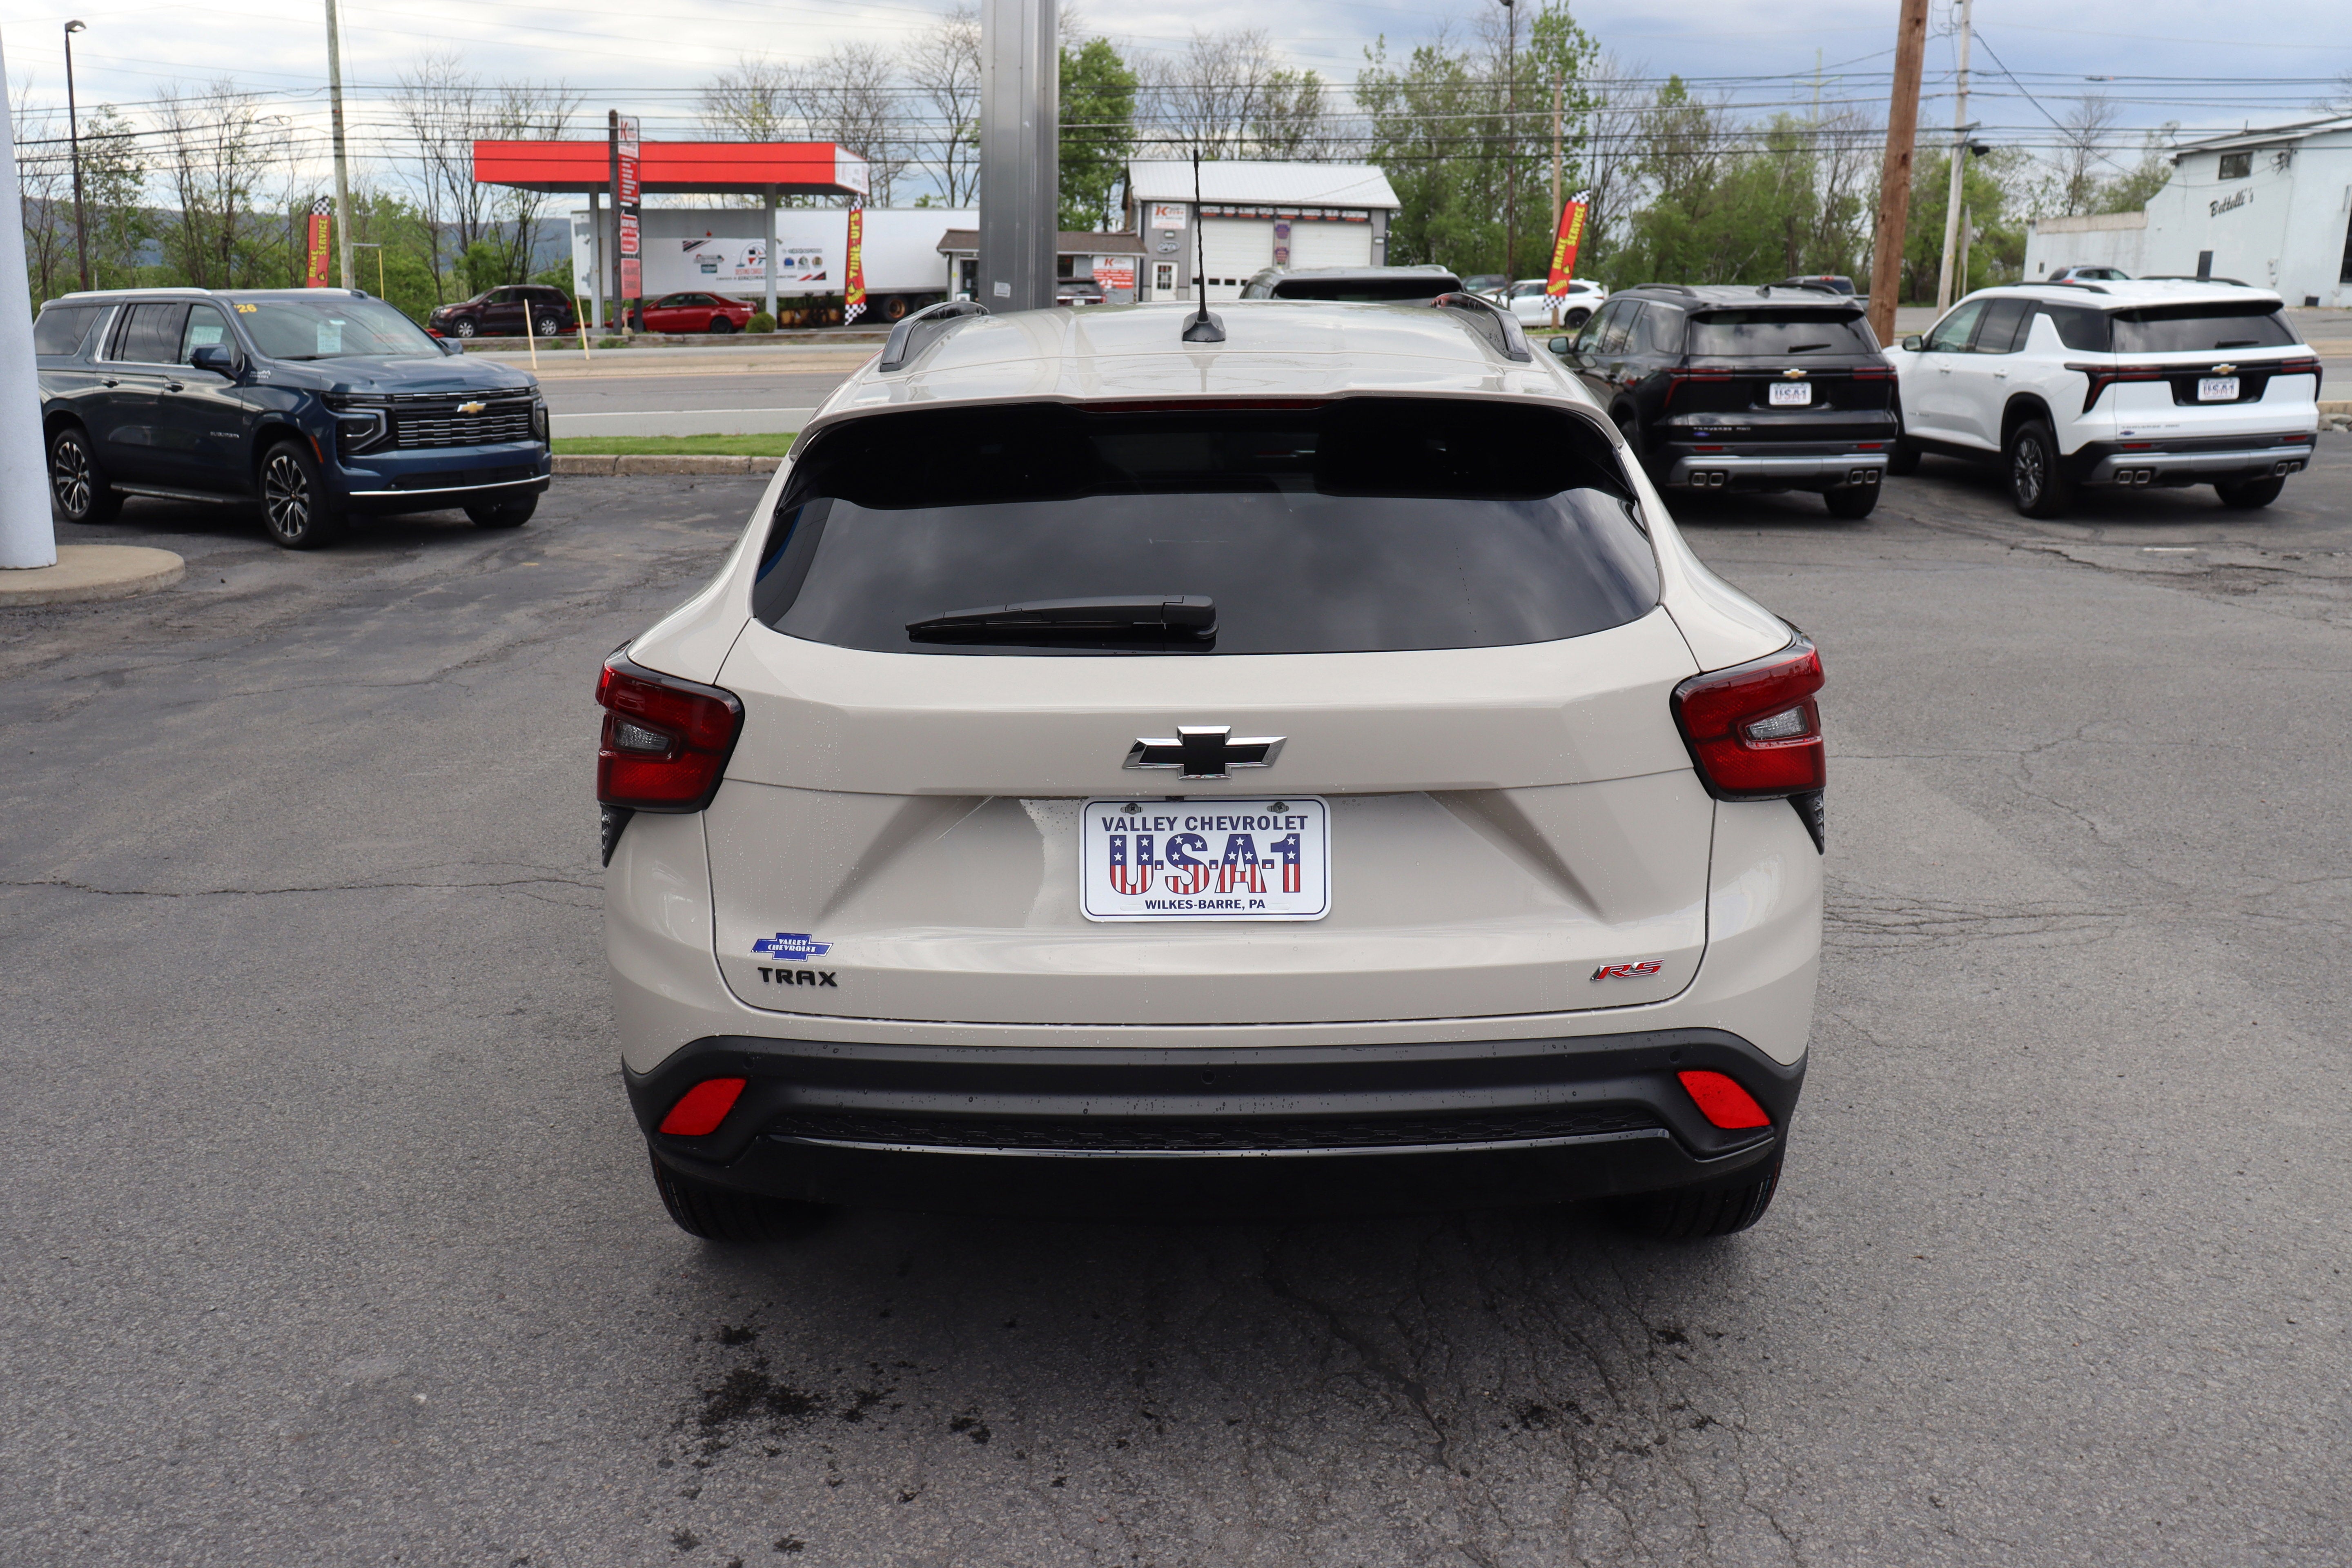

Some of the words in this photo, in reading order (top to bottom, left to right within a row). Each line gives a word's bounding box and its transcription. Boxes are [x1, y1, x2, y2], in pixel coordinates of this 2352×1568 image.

[318, 218, 327, 256] SERVICE
[1567, 205, 1586, 246] SERVICE
[309, 249, 318, 277] BRAKE
[1552, 236, 1568, 270] BRAKE
[1102, 816, 1178, 831] VALLEY
[1185, 815, 1308, 831] CHEVROLET
[1145, 900, 1245, 911] WILKES-BARRE,
[1249, 900, 1265, 909] PA
[768, 944, 816, 953] CHEVROLET
[757, 967, 838, 987] TRAX
[1590, 959, 1665, 982] RS
